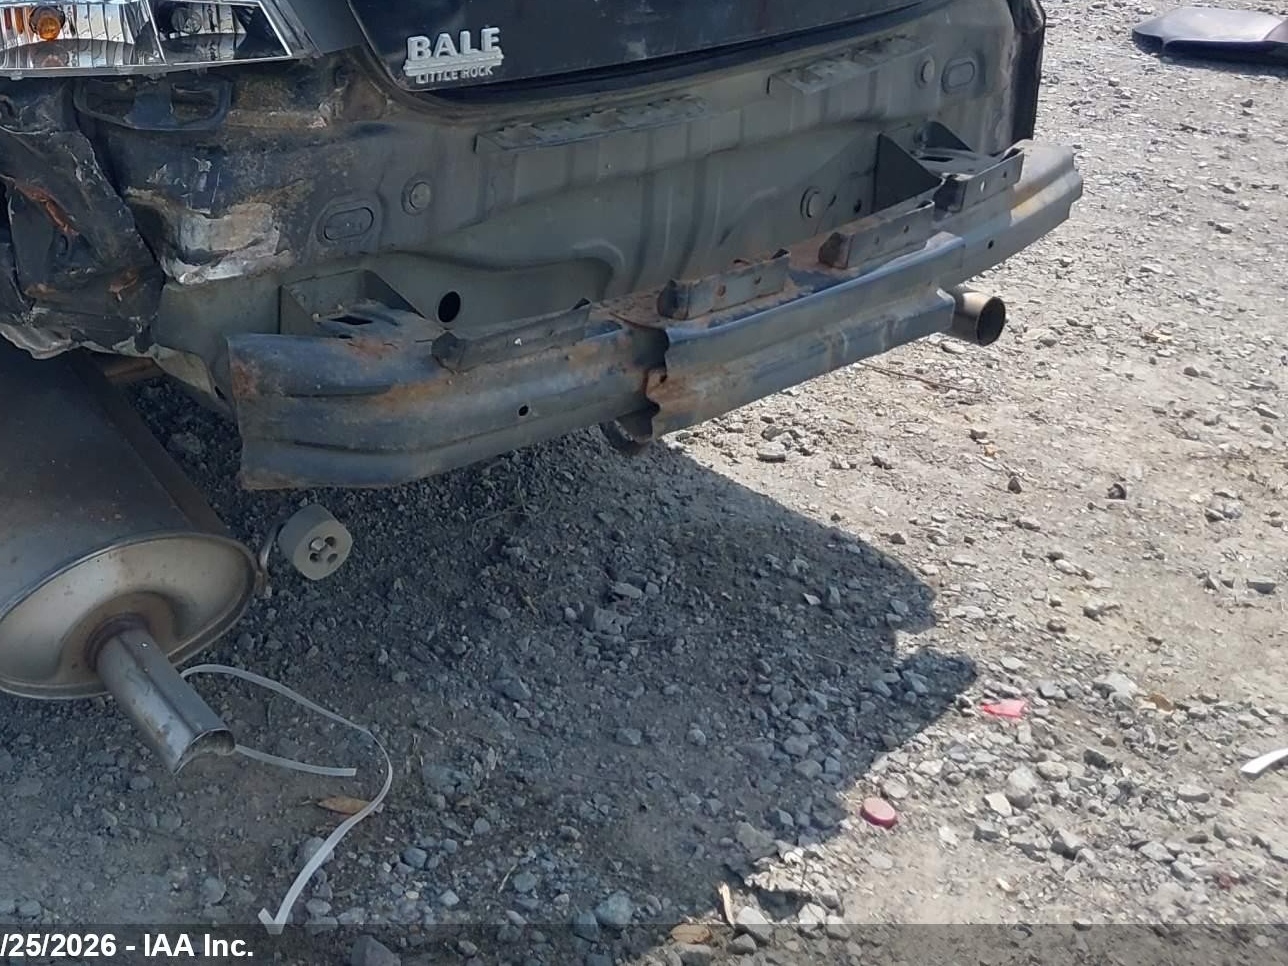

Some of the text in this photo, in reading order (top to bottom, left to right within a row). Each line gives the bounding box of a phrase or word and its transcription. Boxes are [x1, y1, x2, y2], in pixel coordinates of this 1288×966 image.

[406, 26, 502, 62] BALE
[415, 65, 494, 85] LITTLE ROCK
